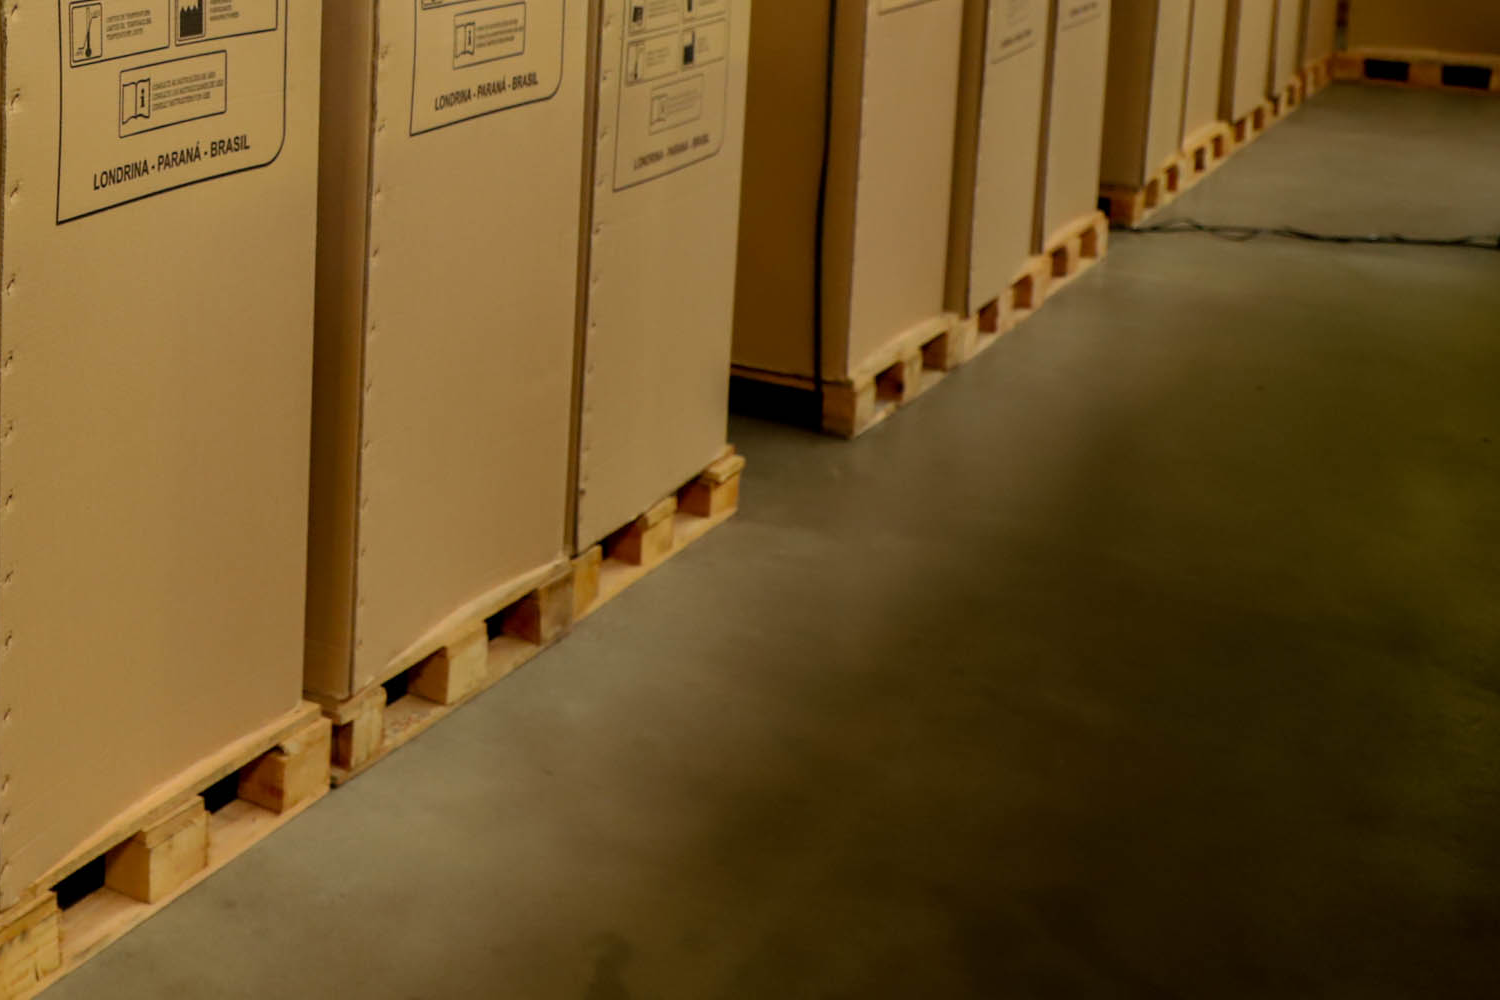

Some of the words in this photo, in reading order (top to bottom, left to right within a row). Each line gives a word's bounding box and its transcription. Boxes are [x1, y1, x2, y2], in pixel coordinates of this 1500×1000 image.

[434, 88, 471, 111] LONDRINA
[512, 72, 538, 90] BRASIL
[93, 158, 150, 191] LONDRINA
[157, 141, 201, 172] PARANÁ
[210, 134, 250, 157] BRASIL
